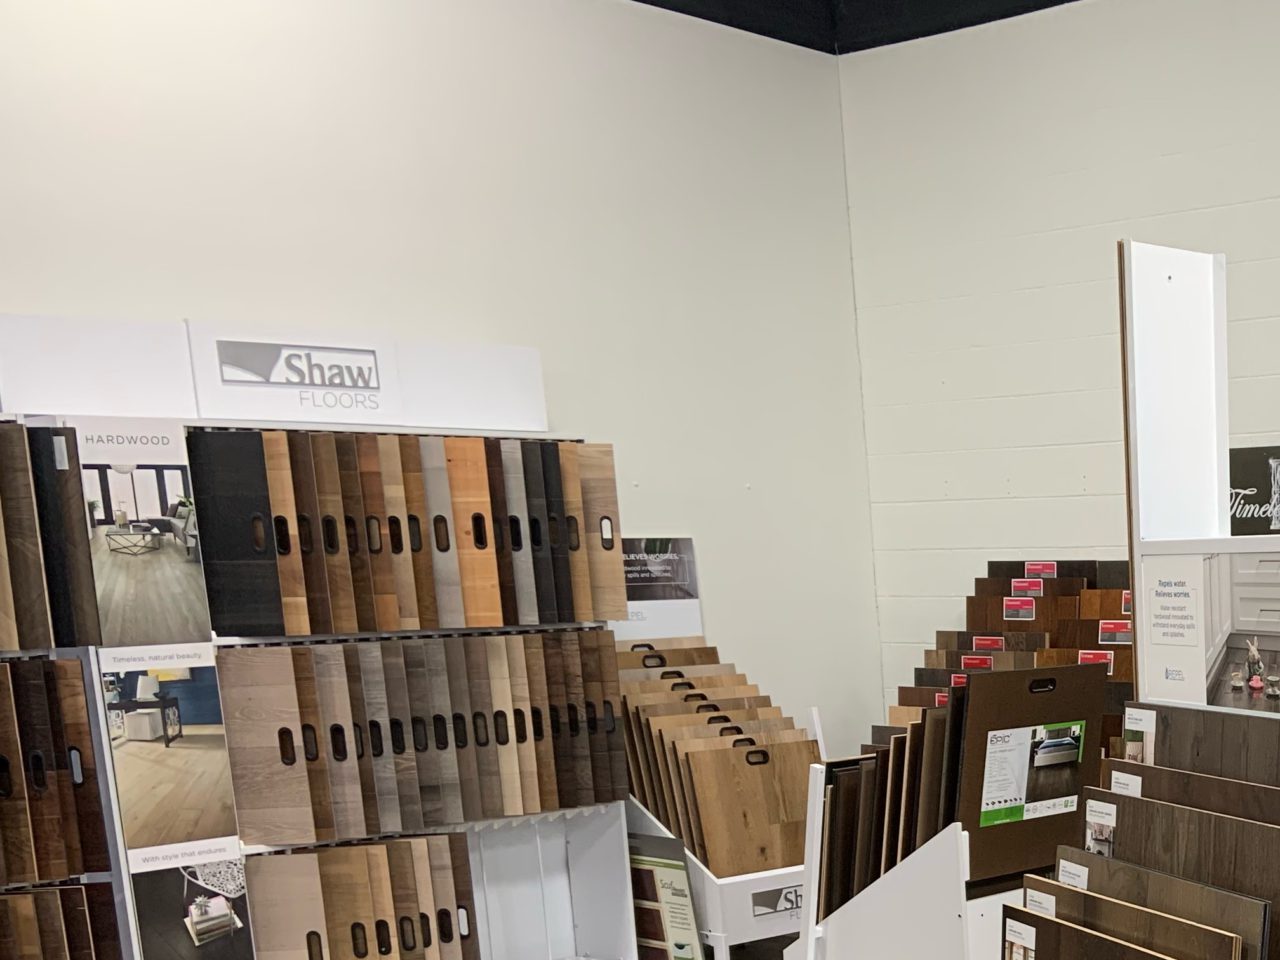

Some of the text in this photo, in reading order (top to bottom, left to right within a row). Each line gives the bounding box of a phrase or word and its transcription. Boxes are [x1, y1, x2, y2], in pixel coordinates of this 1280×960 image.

[284, 352, 372, 387] Shaw
[299, 391, 379, 410] FLOORS
[85, 435, 170, 446] HARDWOOD
[148, 653, 175, 661] natural
